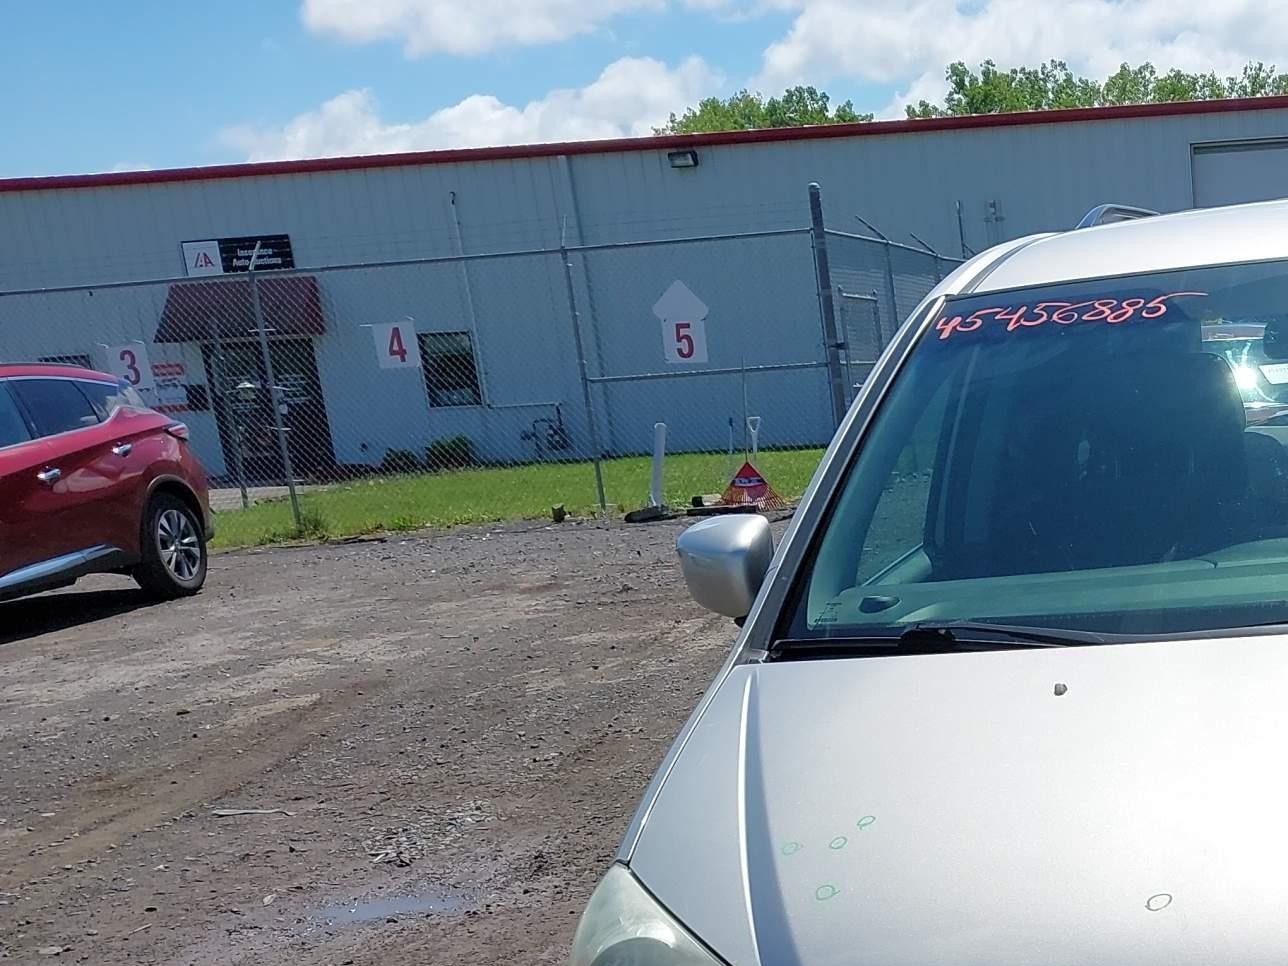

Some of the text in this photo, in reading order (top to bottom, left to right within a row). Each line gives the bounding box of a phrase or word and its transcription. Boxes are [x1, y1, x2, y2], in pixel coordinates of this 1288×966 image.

[237, 247, 273, 257] Insunce
[251, 256, 282, 266] uctions
[936, 292, 1209, 339] 45456885
[388, 326, 407, 363] 4
[675, 323, 694, 359] 5
[120, 350, 141, 385] 3
